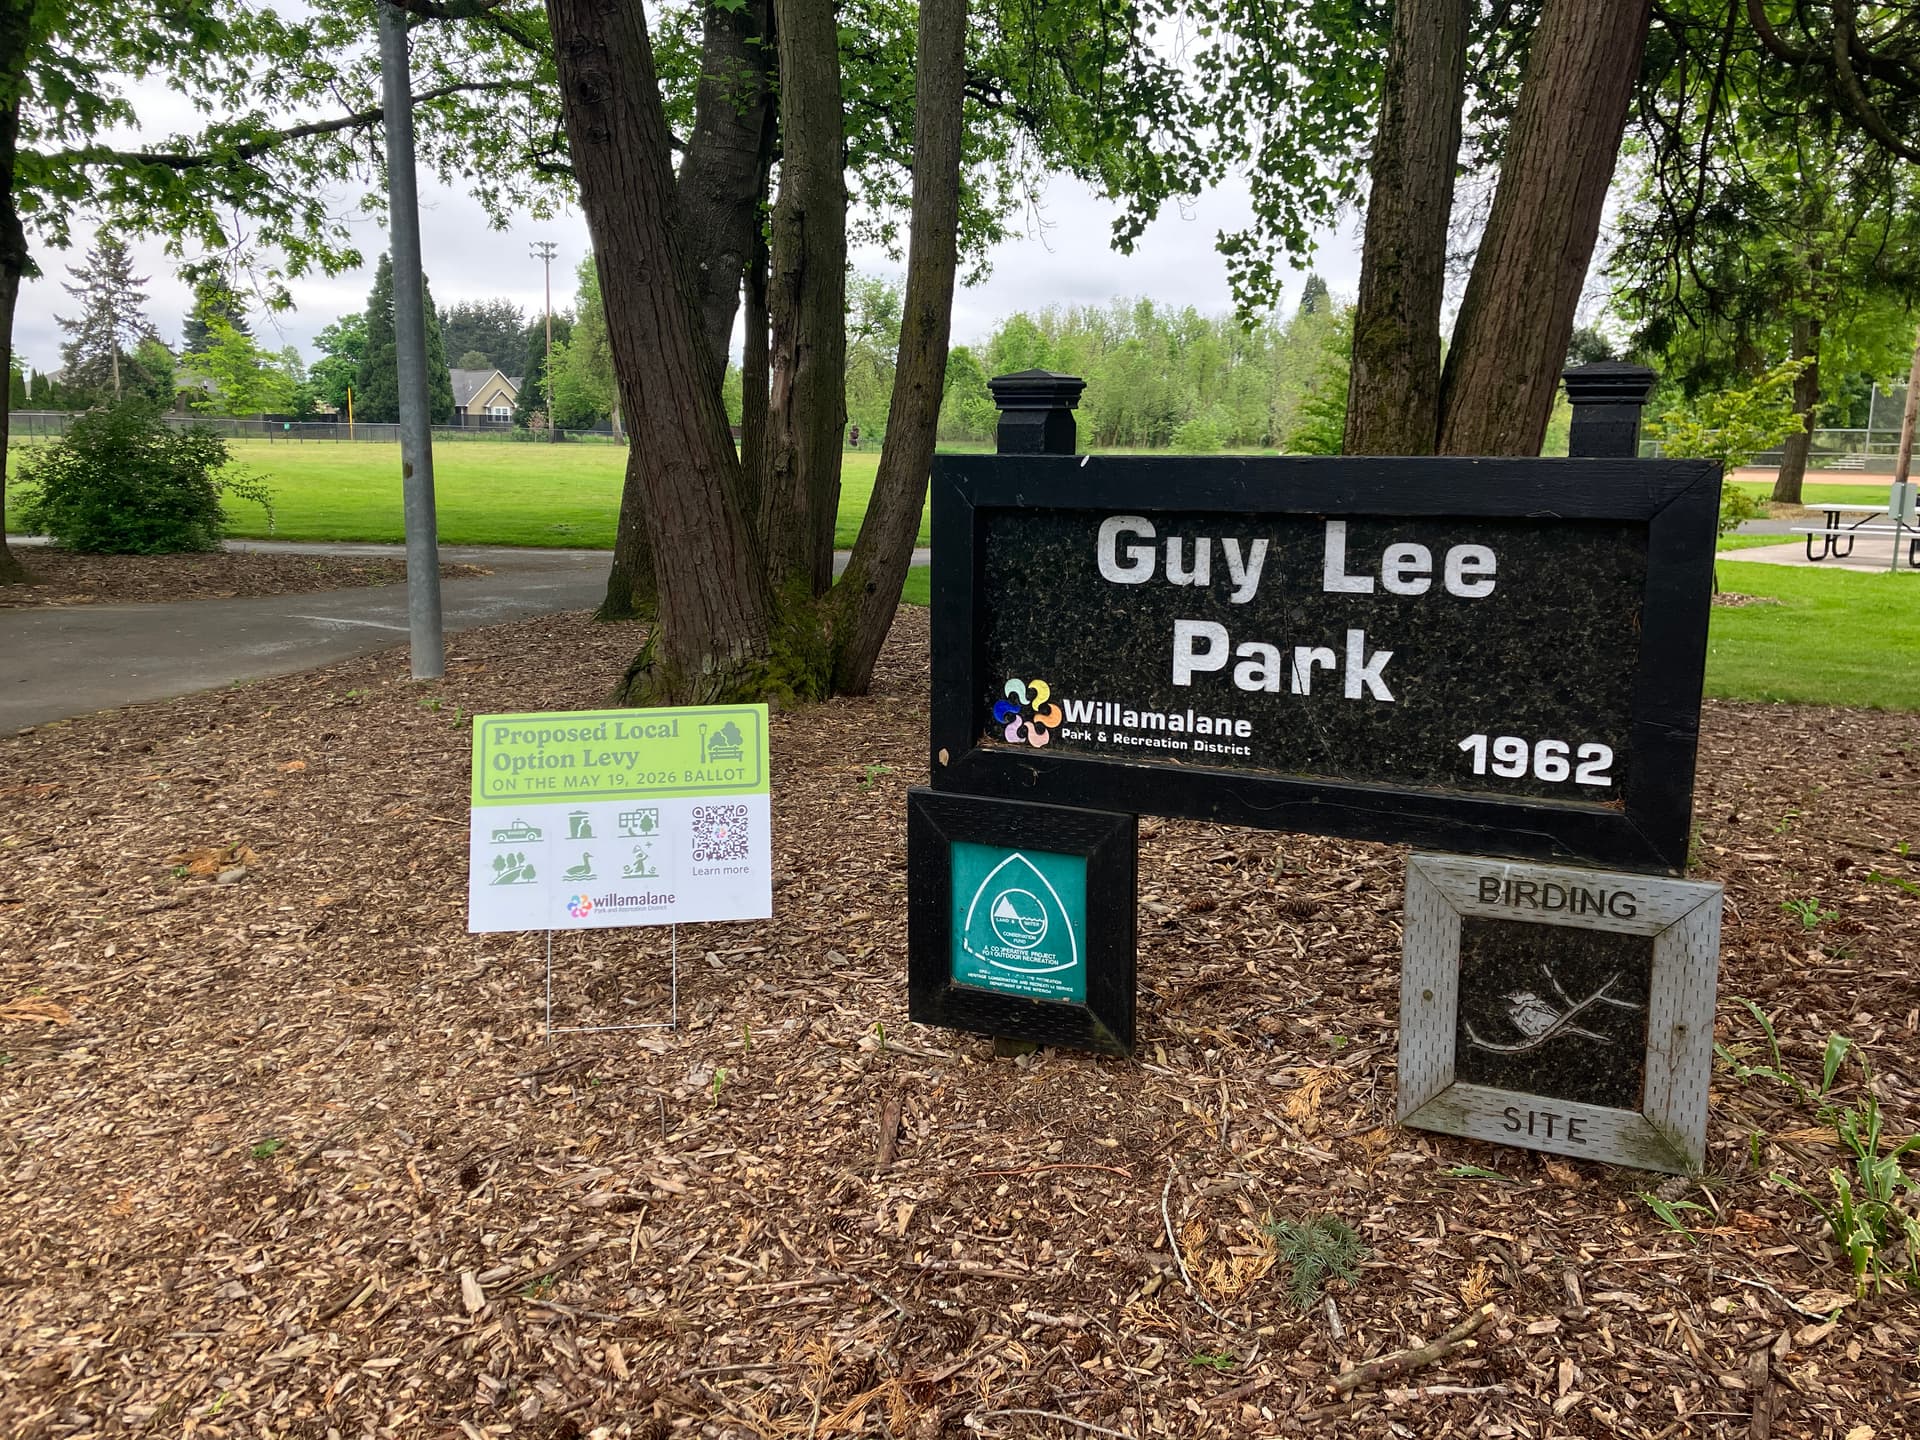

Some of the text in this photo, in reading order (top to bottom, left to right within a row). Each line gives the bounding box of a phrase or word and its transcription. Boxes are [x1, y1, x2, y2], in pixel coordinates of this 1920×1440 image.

[1097, 515, 1496, 604] Guy Lee
[1172, 619, 1395, 701] Park
[1063, 699, 1251, 738] Willamalane
[494, 719, 679, 748] Proposed Local
[1061, 728, 1251, 756] Park & Recreation District
[493, 749, 640, 775] Option Levy
[1458, 734, 1613, 786] 1962
[493, 768, 745, 791] ON THE MAY 19, 2026 BALLOT
[693, 866, 749, 876] Learn more
[593, 892, 675, 907] willamalane
[1479, 876, 1637, 919] BIRDING
[994, 951, 1021, 960] OUTDOOR
[1023, 955, 1058, 965] RECREATION
[1031, 950, 1056, 959] PROJECT
[1503, 1107, 1588, 1145] SITE
